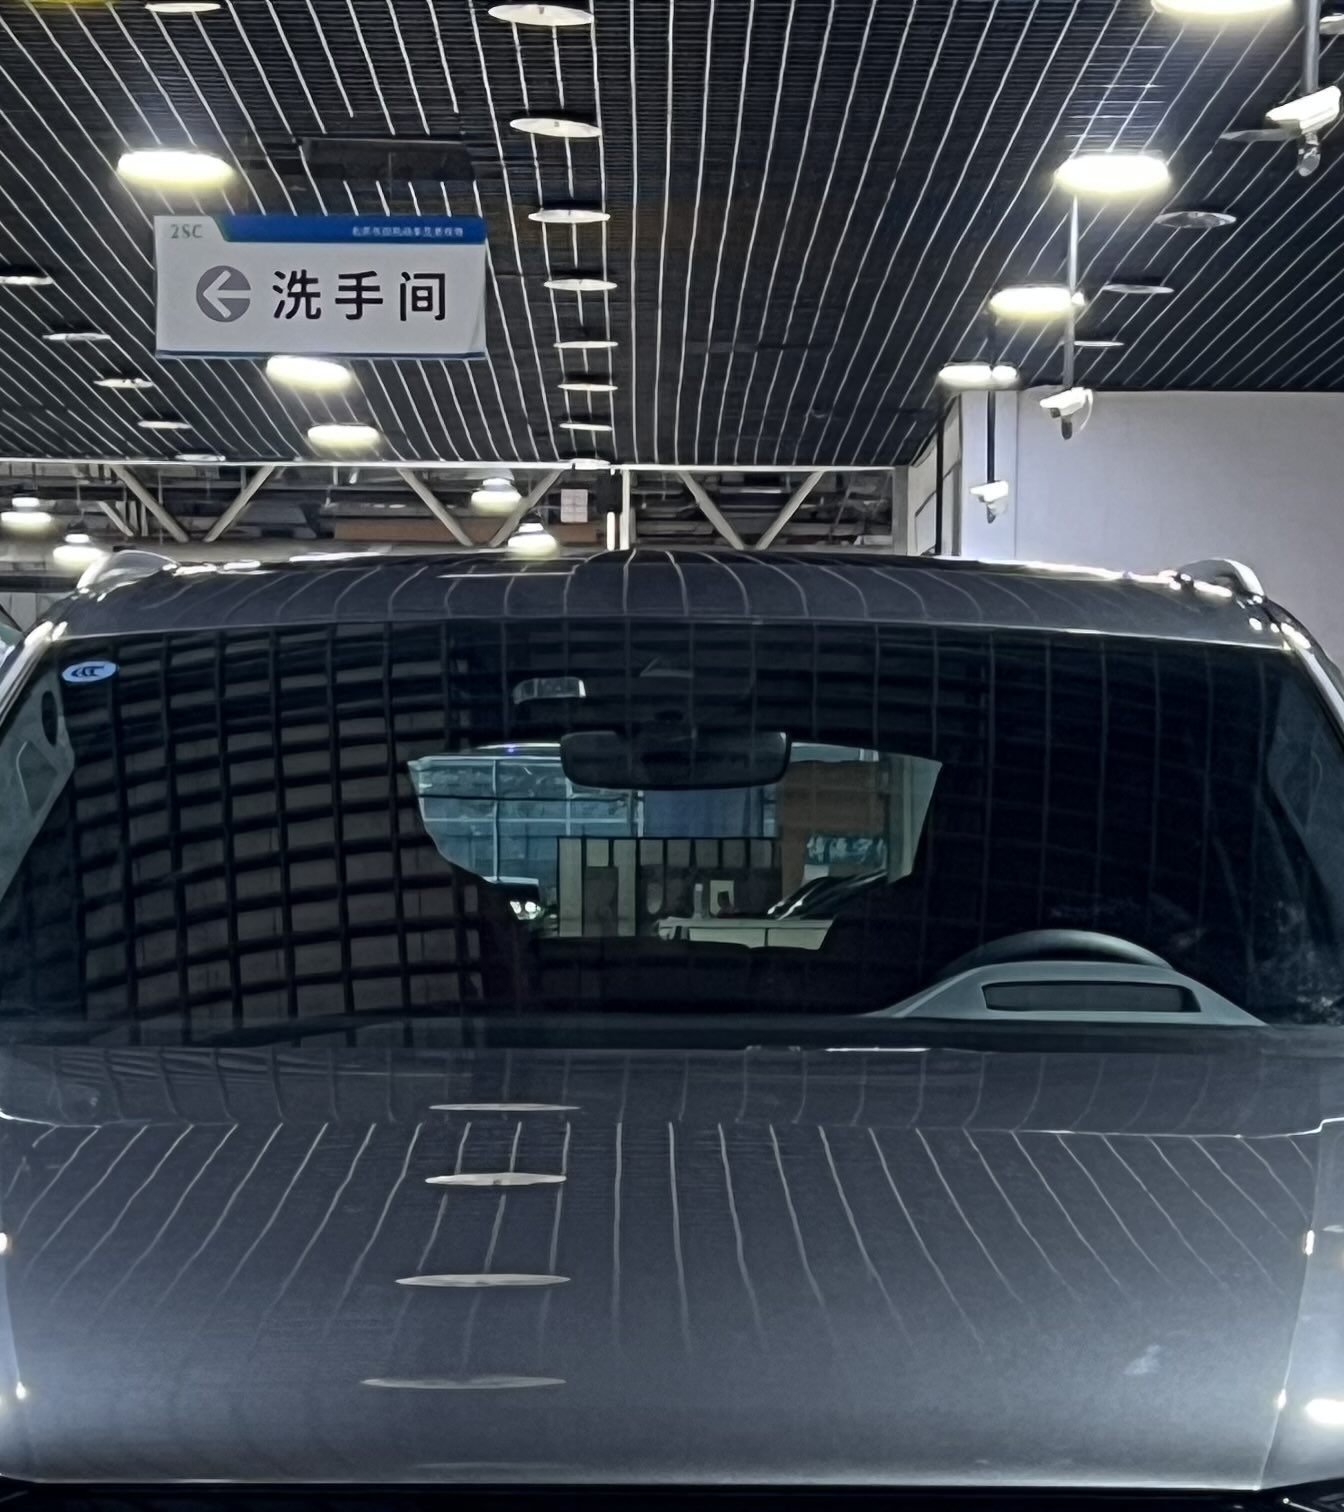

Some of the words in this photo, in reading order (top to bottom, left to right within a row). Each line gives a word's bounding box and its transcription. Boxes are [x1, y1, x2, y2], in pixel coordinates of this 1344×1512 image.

[170, 223, 204, 239] 2SC
[271, 268, 447, 322] 洗手间
